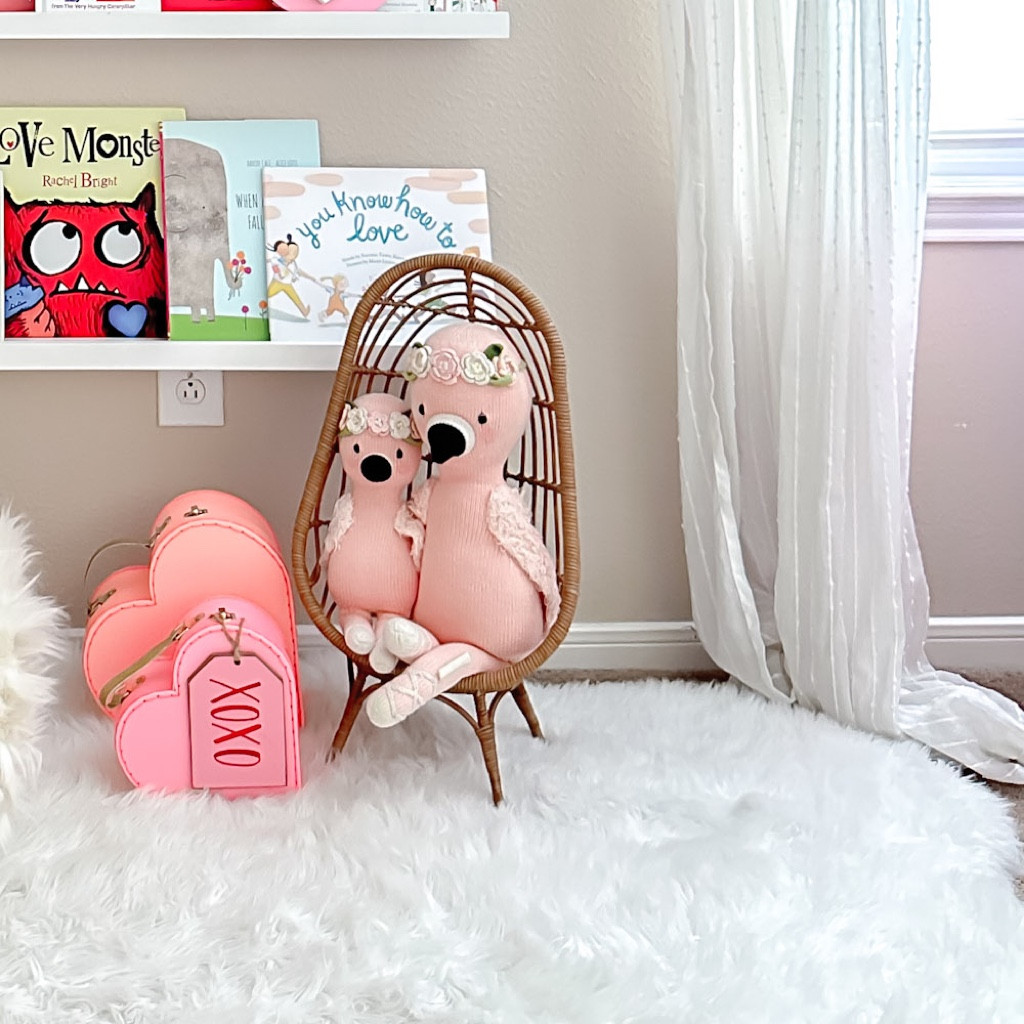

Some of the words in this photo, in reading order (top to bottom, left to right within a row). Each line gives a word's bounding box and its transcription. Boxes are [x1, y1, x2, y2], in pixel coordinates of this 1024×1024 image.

[42, 174, 77, 188] Rachel
[81, 172, 117, 188] Bright
[235, 192, 258, 208] WHEN
[394, 184, 437, 231] how
[437, 222, 457, 248] to
[208, 677, 262, 767] XOXO
